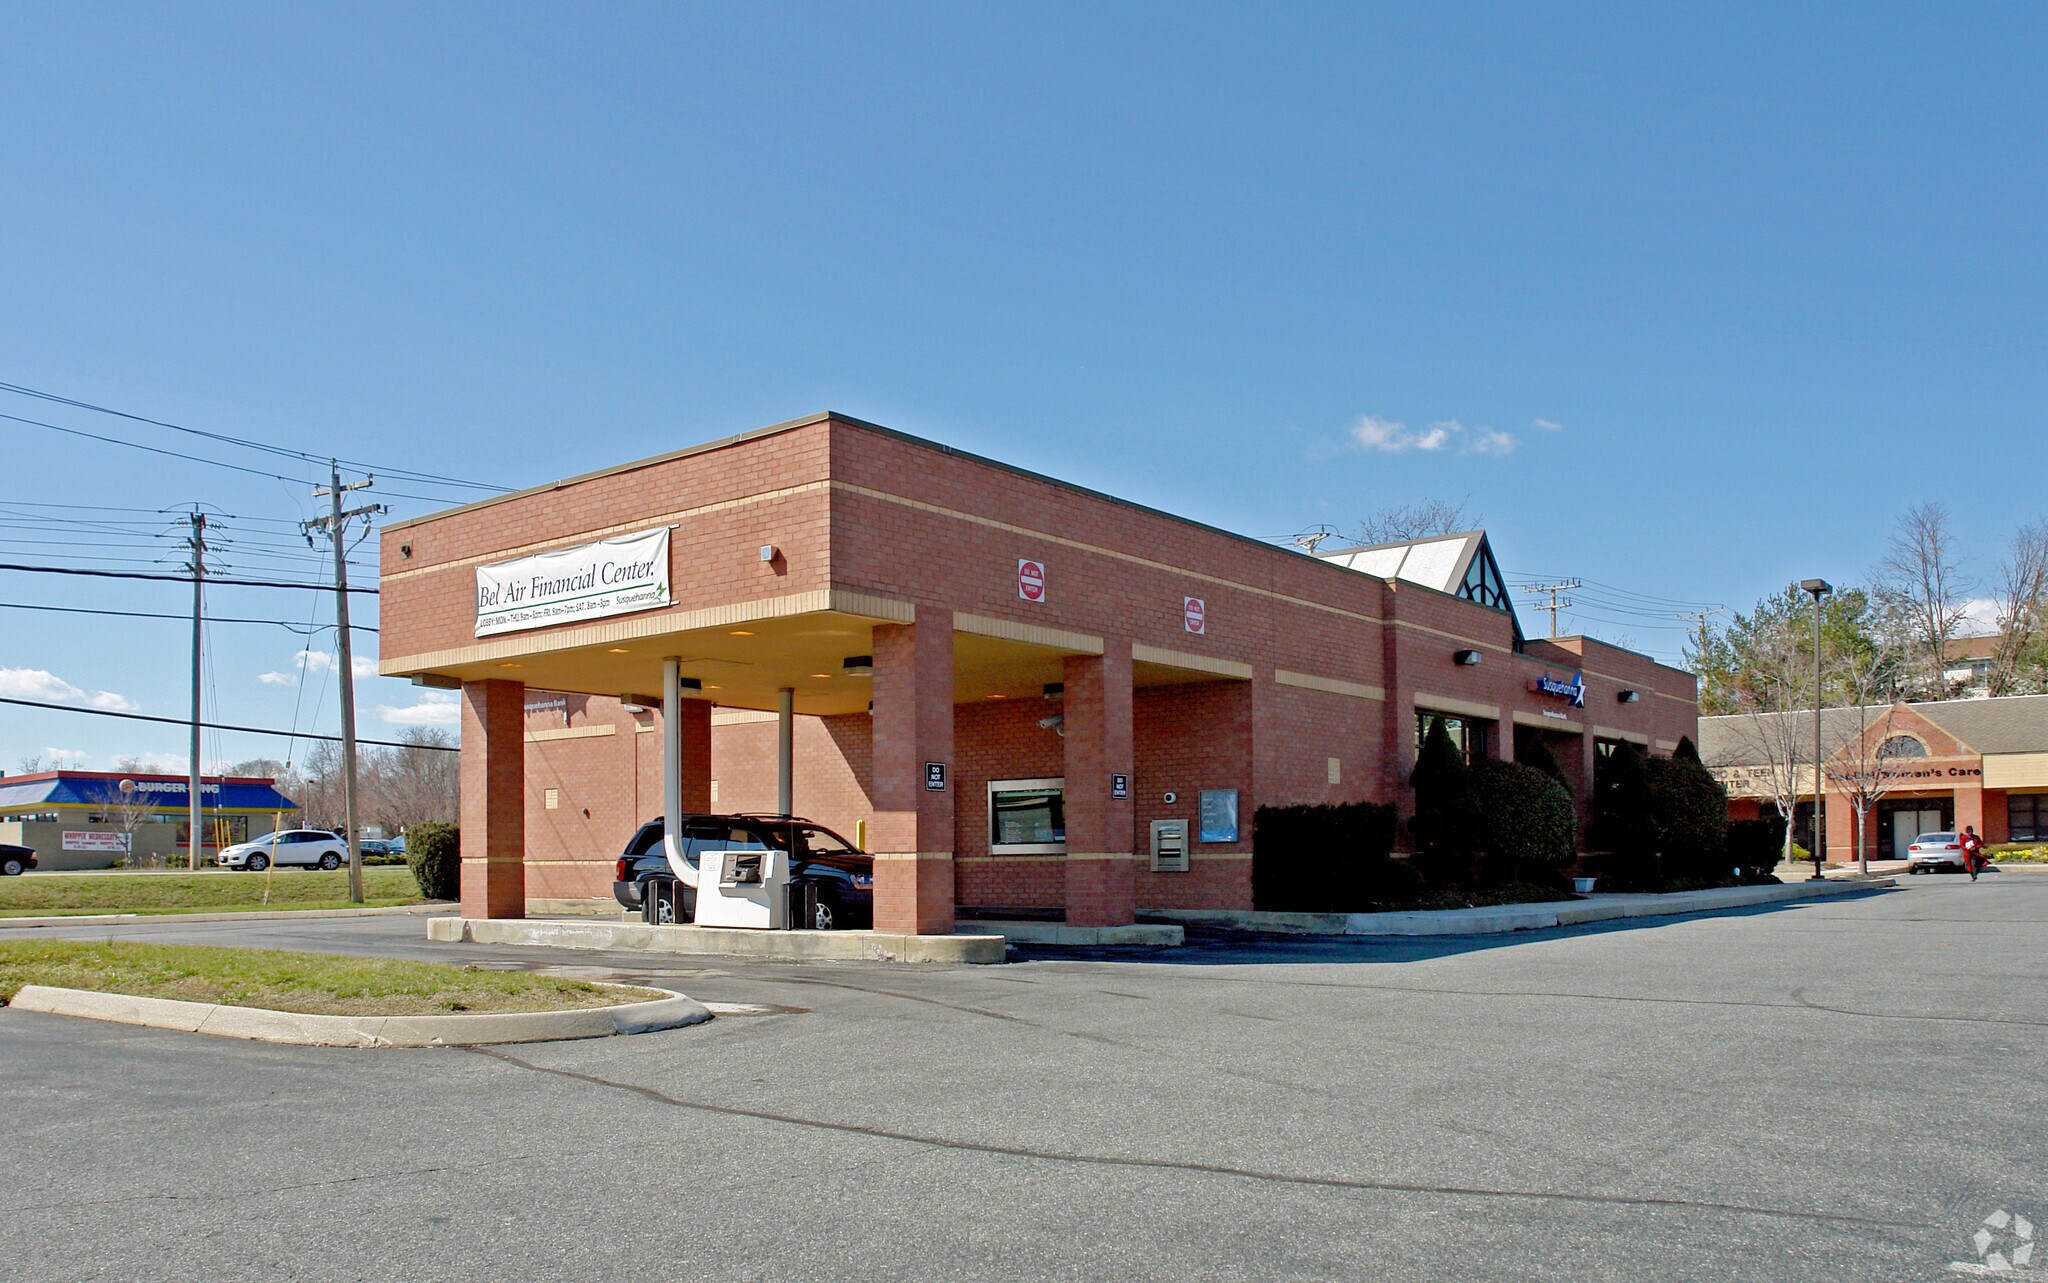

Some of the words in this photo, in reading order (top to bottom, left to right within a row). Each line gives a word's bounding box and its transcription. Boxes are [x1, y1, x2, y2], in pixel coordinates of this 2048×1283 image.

[479, 582, 500, 607] Bel
[504, 580, 526, 604] Air
[530, 563, 596, 599] Financial
[601, 560, 654, 585] Center.
[616, 591, 656, 605] Susquehanna
[1948, 767, 1982, 776] Care
[138, 782, 186, 793] BURGER
